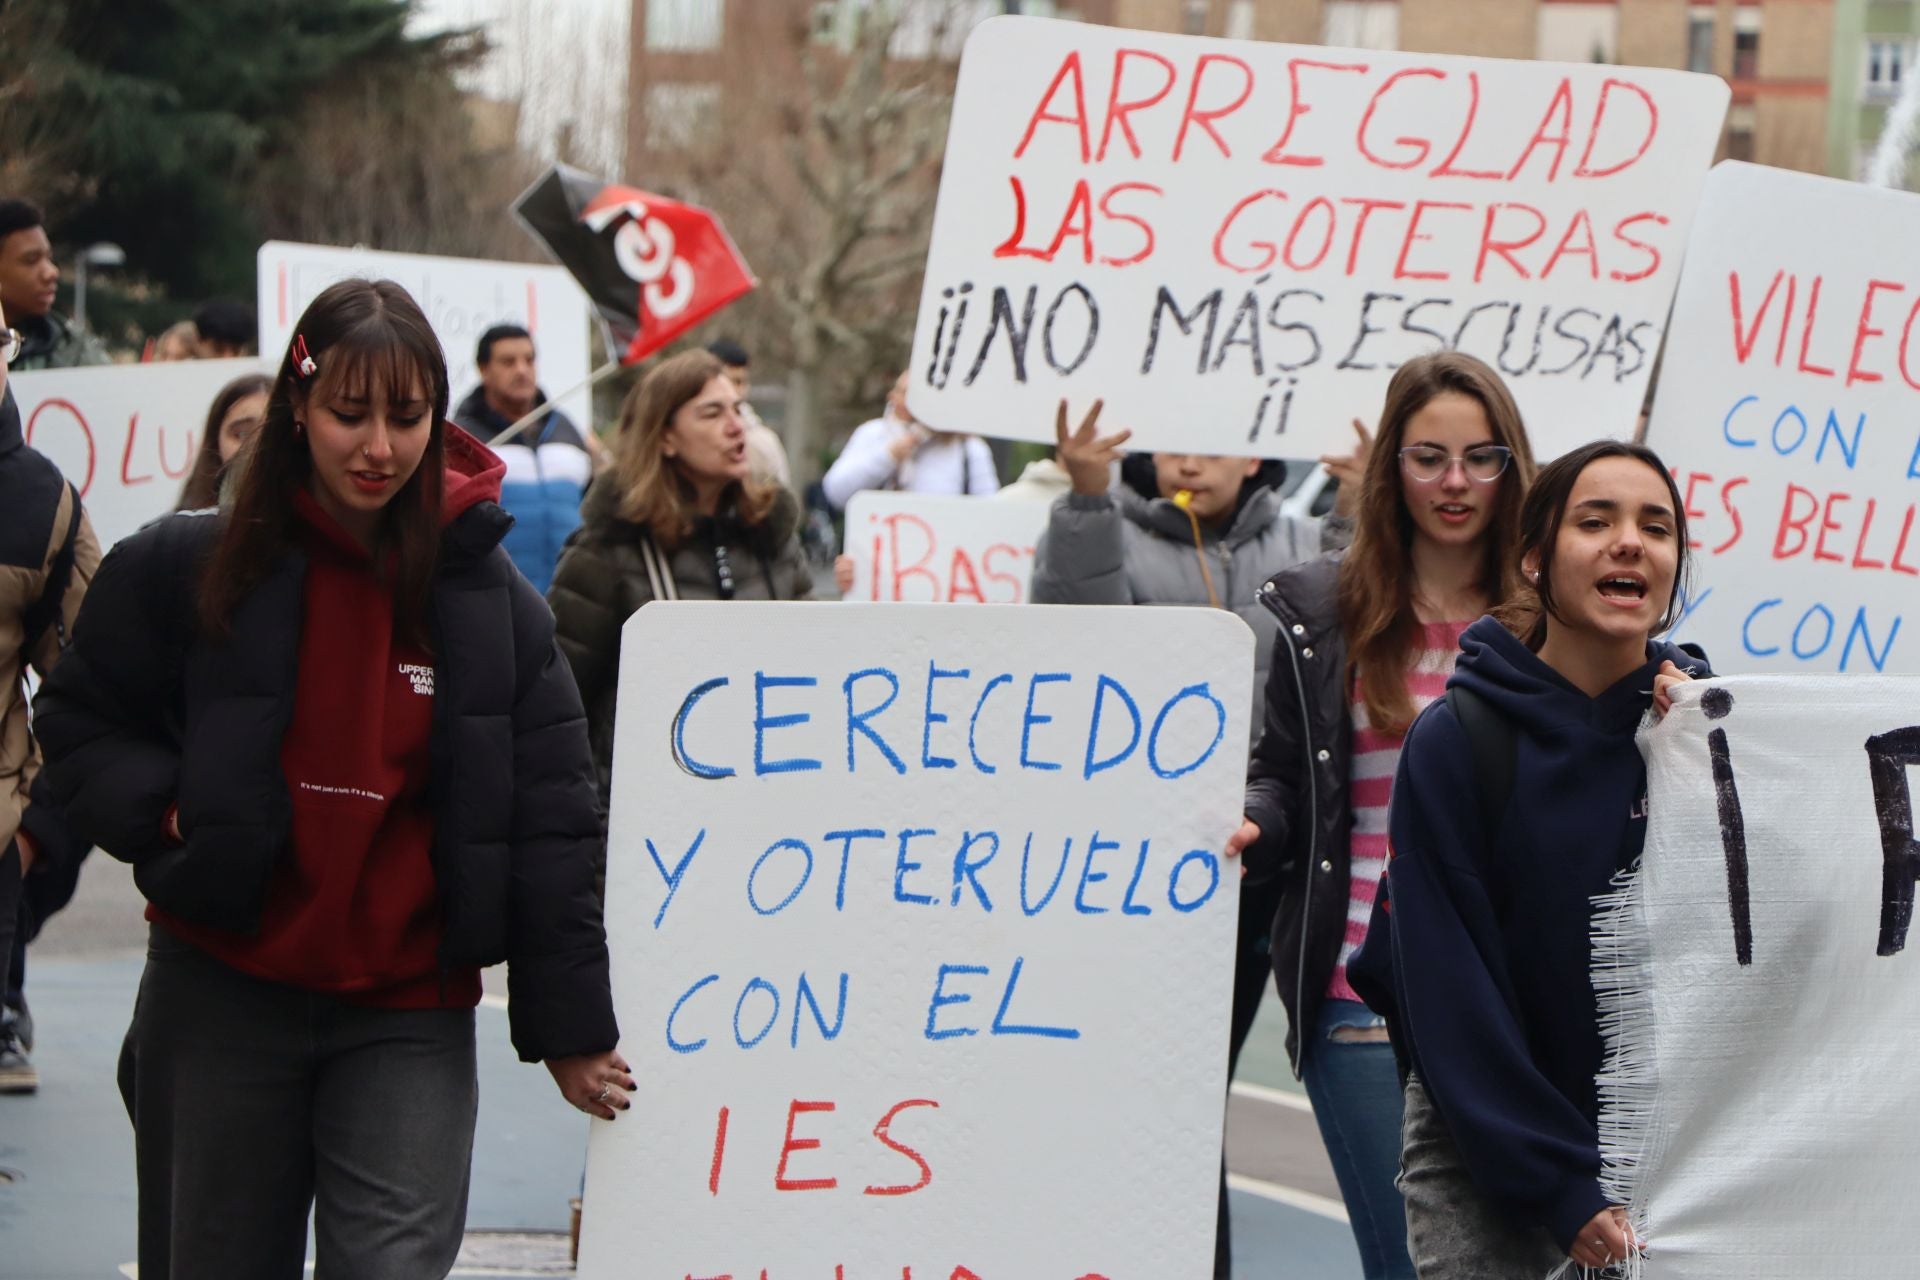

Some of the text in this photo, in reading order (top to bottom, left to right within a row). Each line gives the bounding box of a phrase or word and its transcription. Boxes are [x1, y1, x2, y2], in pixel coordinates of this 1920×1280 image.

[1014, 48, 1659, 182] ARREGLAD
[993, 176, 1670, 283] LAS GOTERAS
[1141, 272, 1324, 374] MÁS
[1336, 292, 1653, 383] ESCUSAS
[1723, 394, 1867, 470] CON
[868, 513, 1036, 603] ¡BAS
[1741, 597, 1902, 673] CON
[671, 659, 1227, 780] CERECEDO
[645, 827, 1220, 929] Y OTERUELO
[666, 957, 1081, 1053] CON EL
[709, 1098, 940, 1196] IES
